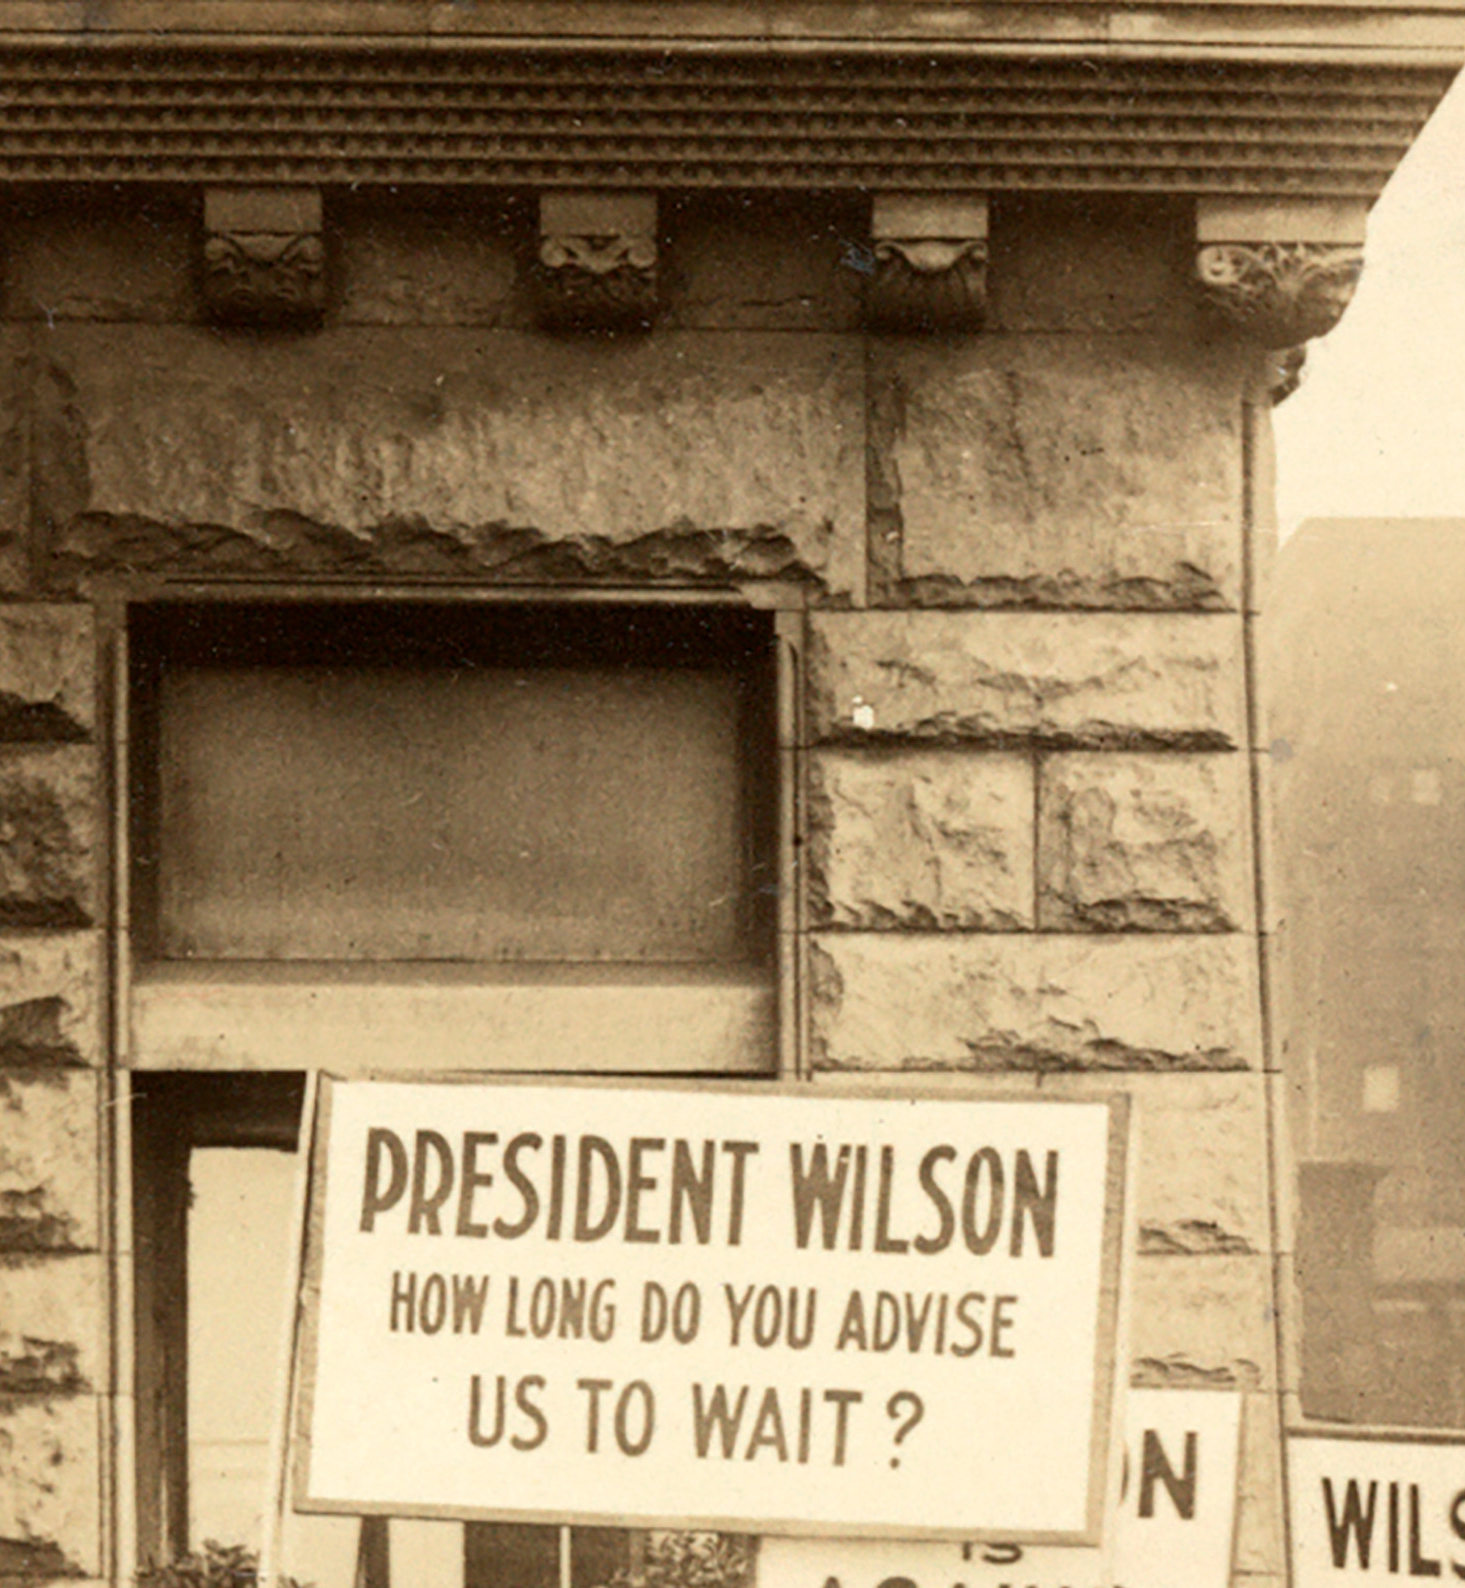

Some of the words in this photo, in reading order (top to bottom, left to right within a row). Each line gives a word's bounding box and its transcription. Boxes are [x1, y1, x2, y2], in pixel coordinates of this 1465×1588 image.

[359, 1127, 760, 1247] PRESIDENT
[789, 1140, 1059, 1259] WILSON
[389, 1270, 489, 1337] HOW
[506, 1274, 616, 1343] LONG
[640, 1281, 701, 1346] DO
[721, 1284, 818, 1350] YOU
[836, 1290, 1018, 1359] ADVISE
[467, 1375, 548, 1452] US
[577, 1379, 656, 1458] TO
